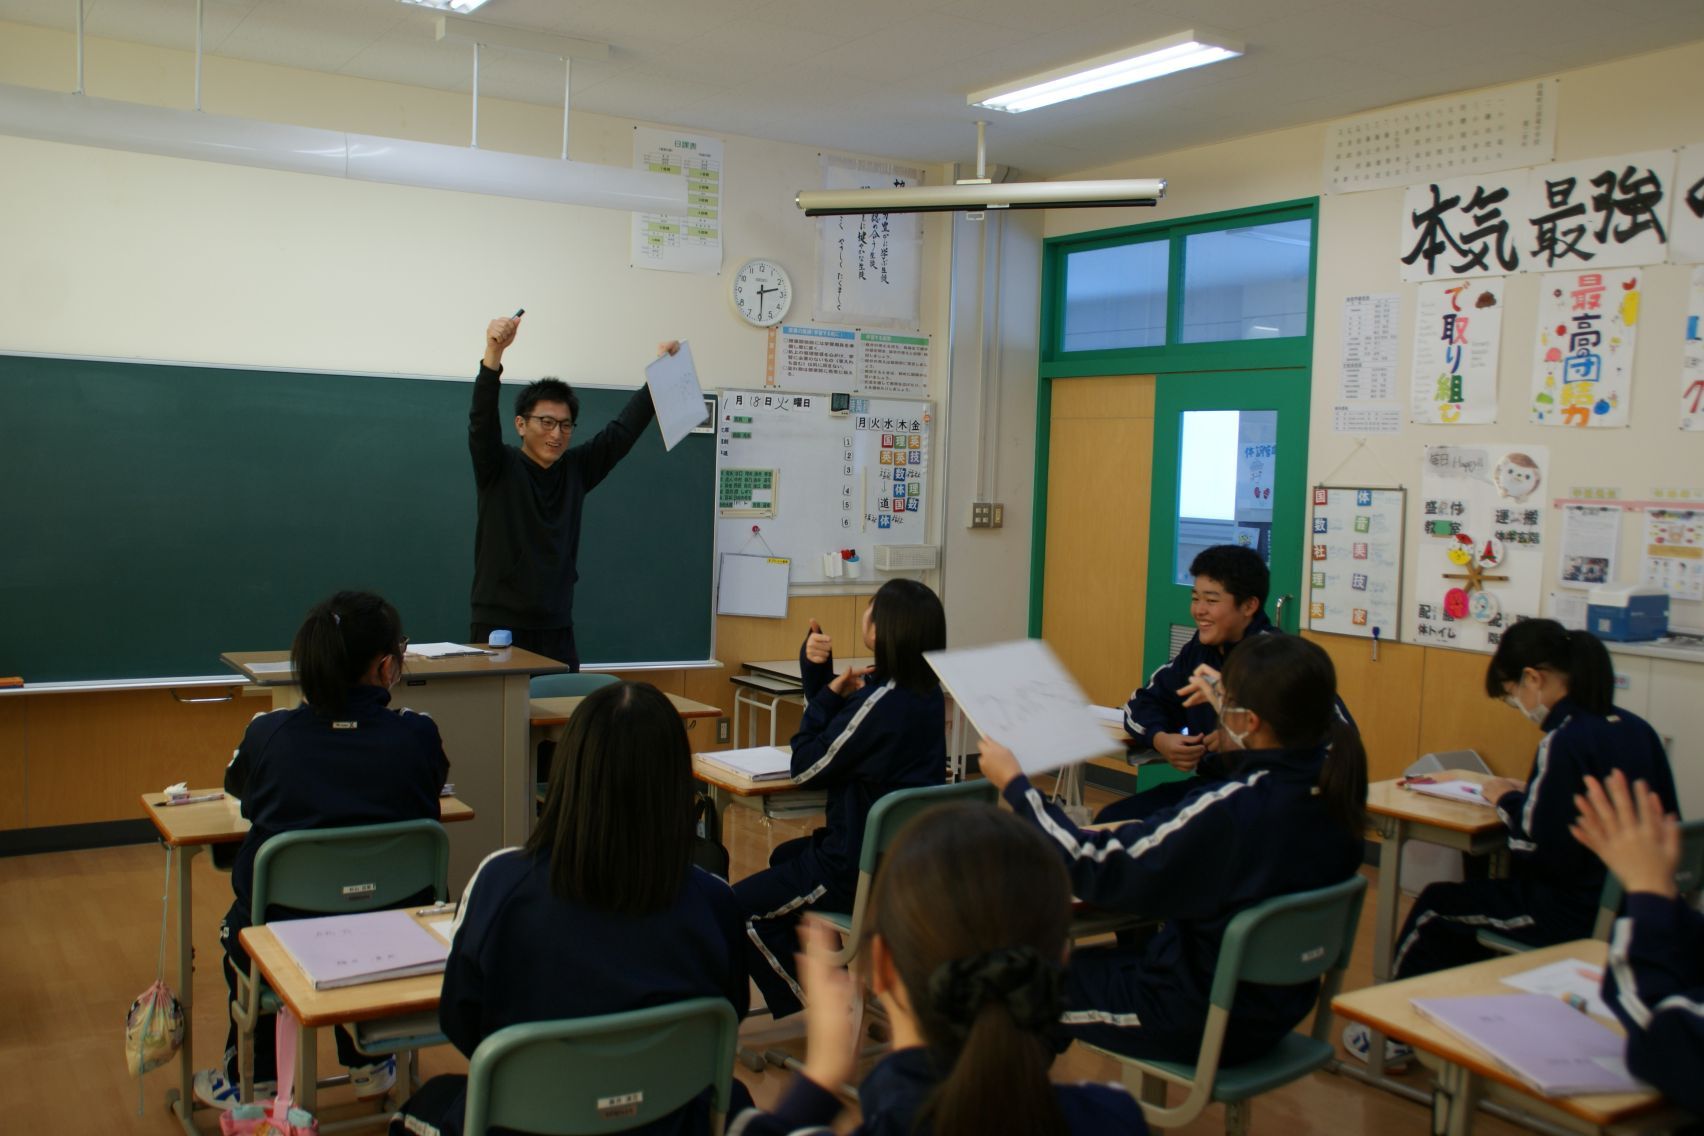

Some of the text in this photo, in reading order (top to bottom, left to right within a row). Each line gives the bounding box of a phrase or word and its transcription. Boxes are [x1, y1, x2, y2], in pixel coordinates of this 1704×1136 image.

[1433, 281, 1471, 423] で取り組む
[858, 417, 921, 431] 月 火 水 木 金
[895, 468, 905, 480] 数
[880, 498, 889, 508] 道
[1315, 490, 1370, 504] 国 体
[1314, 518, 1326, 531] 数
